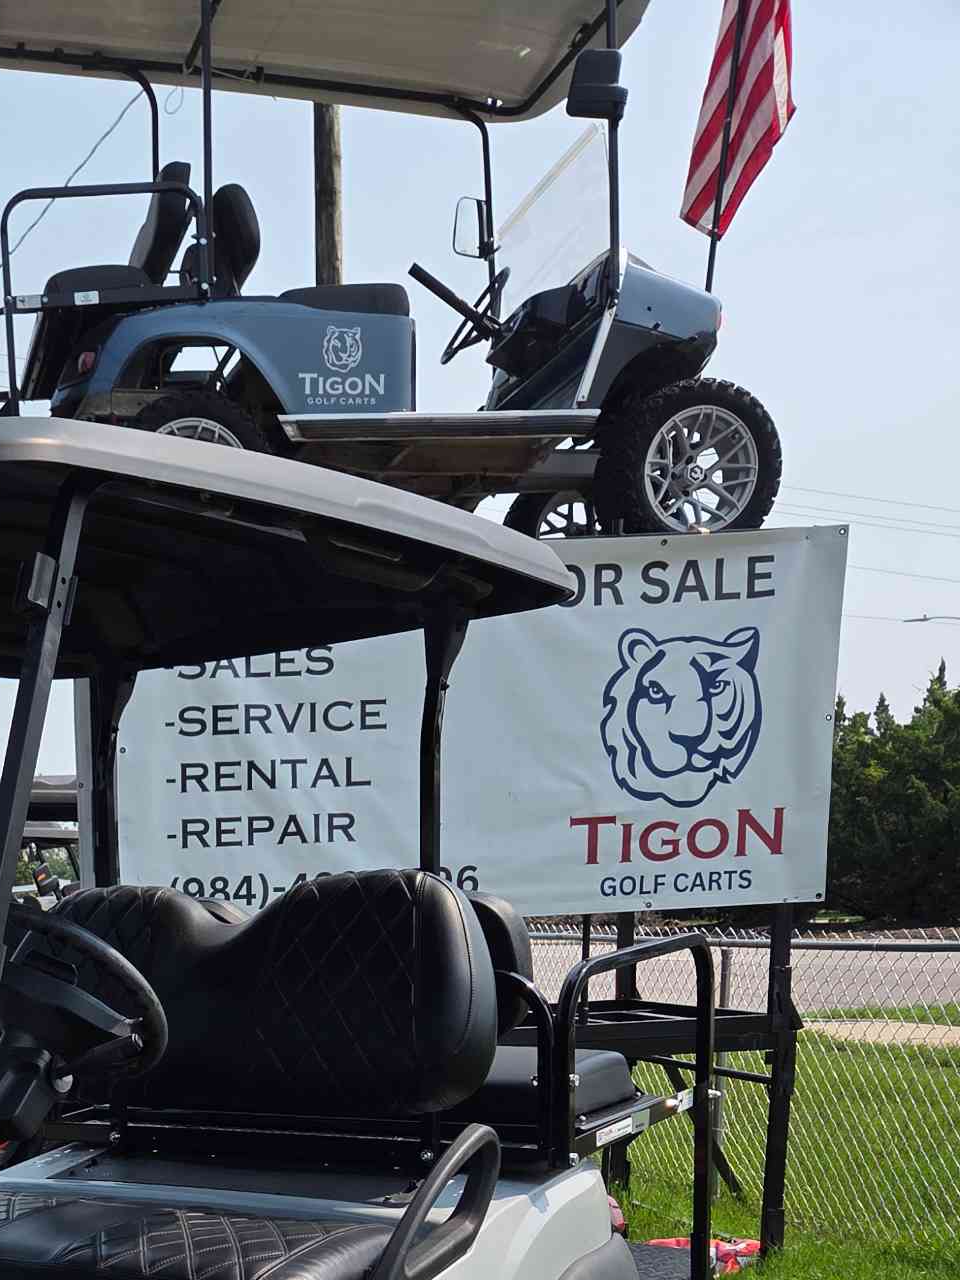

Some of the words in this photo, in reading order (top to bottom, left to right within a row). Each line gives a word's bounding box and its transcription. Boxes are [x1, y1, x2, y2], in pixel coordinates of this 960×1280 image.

[298, 373, 385, 395] TIGON
[306, 397, 337, 405] GOLF
[340, 397, 377, 405] CARTS
[558, 563, 624, 607] OR
[640, 555, 775, 604] SALE
[165, 646, 335, 680] SALES
[165, 699, 387, 737] -SERVICE
[166, 757, 371, 793] -RENTAL
[167, 812, 357, 849] -REPAIR
[570, 808, 785, 864] TIGON
[600, 874, 666, 897] GOLF
[673, 870, 752, 893] CARTS
